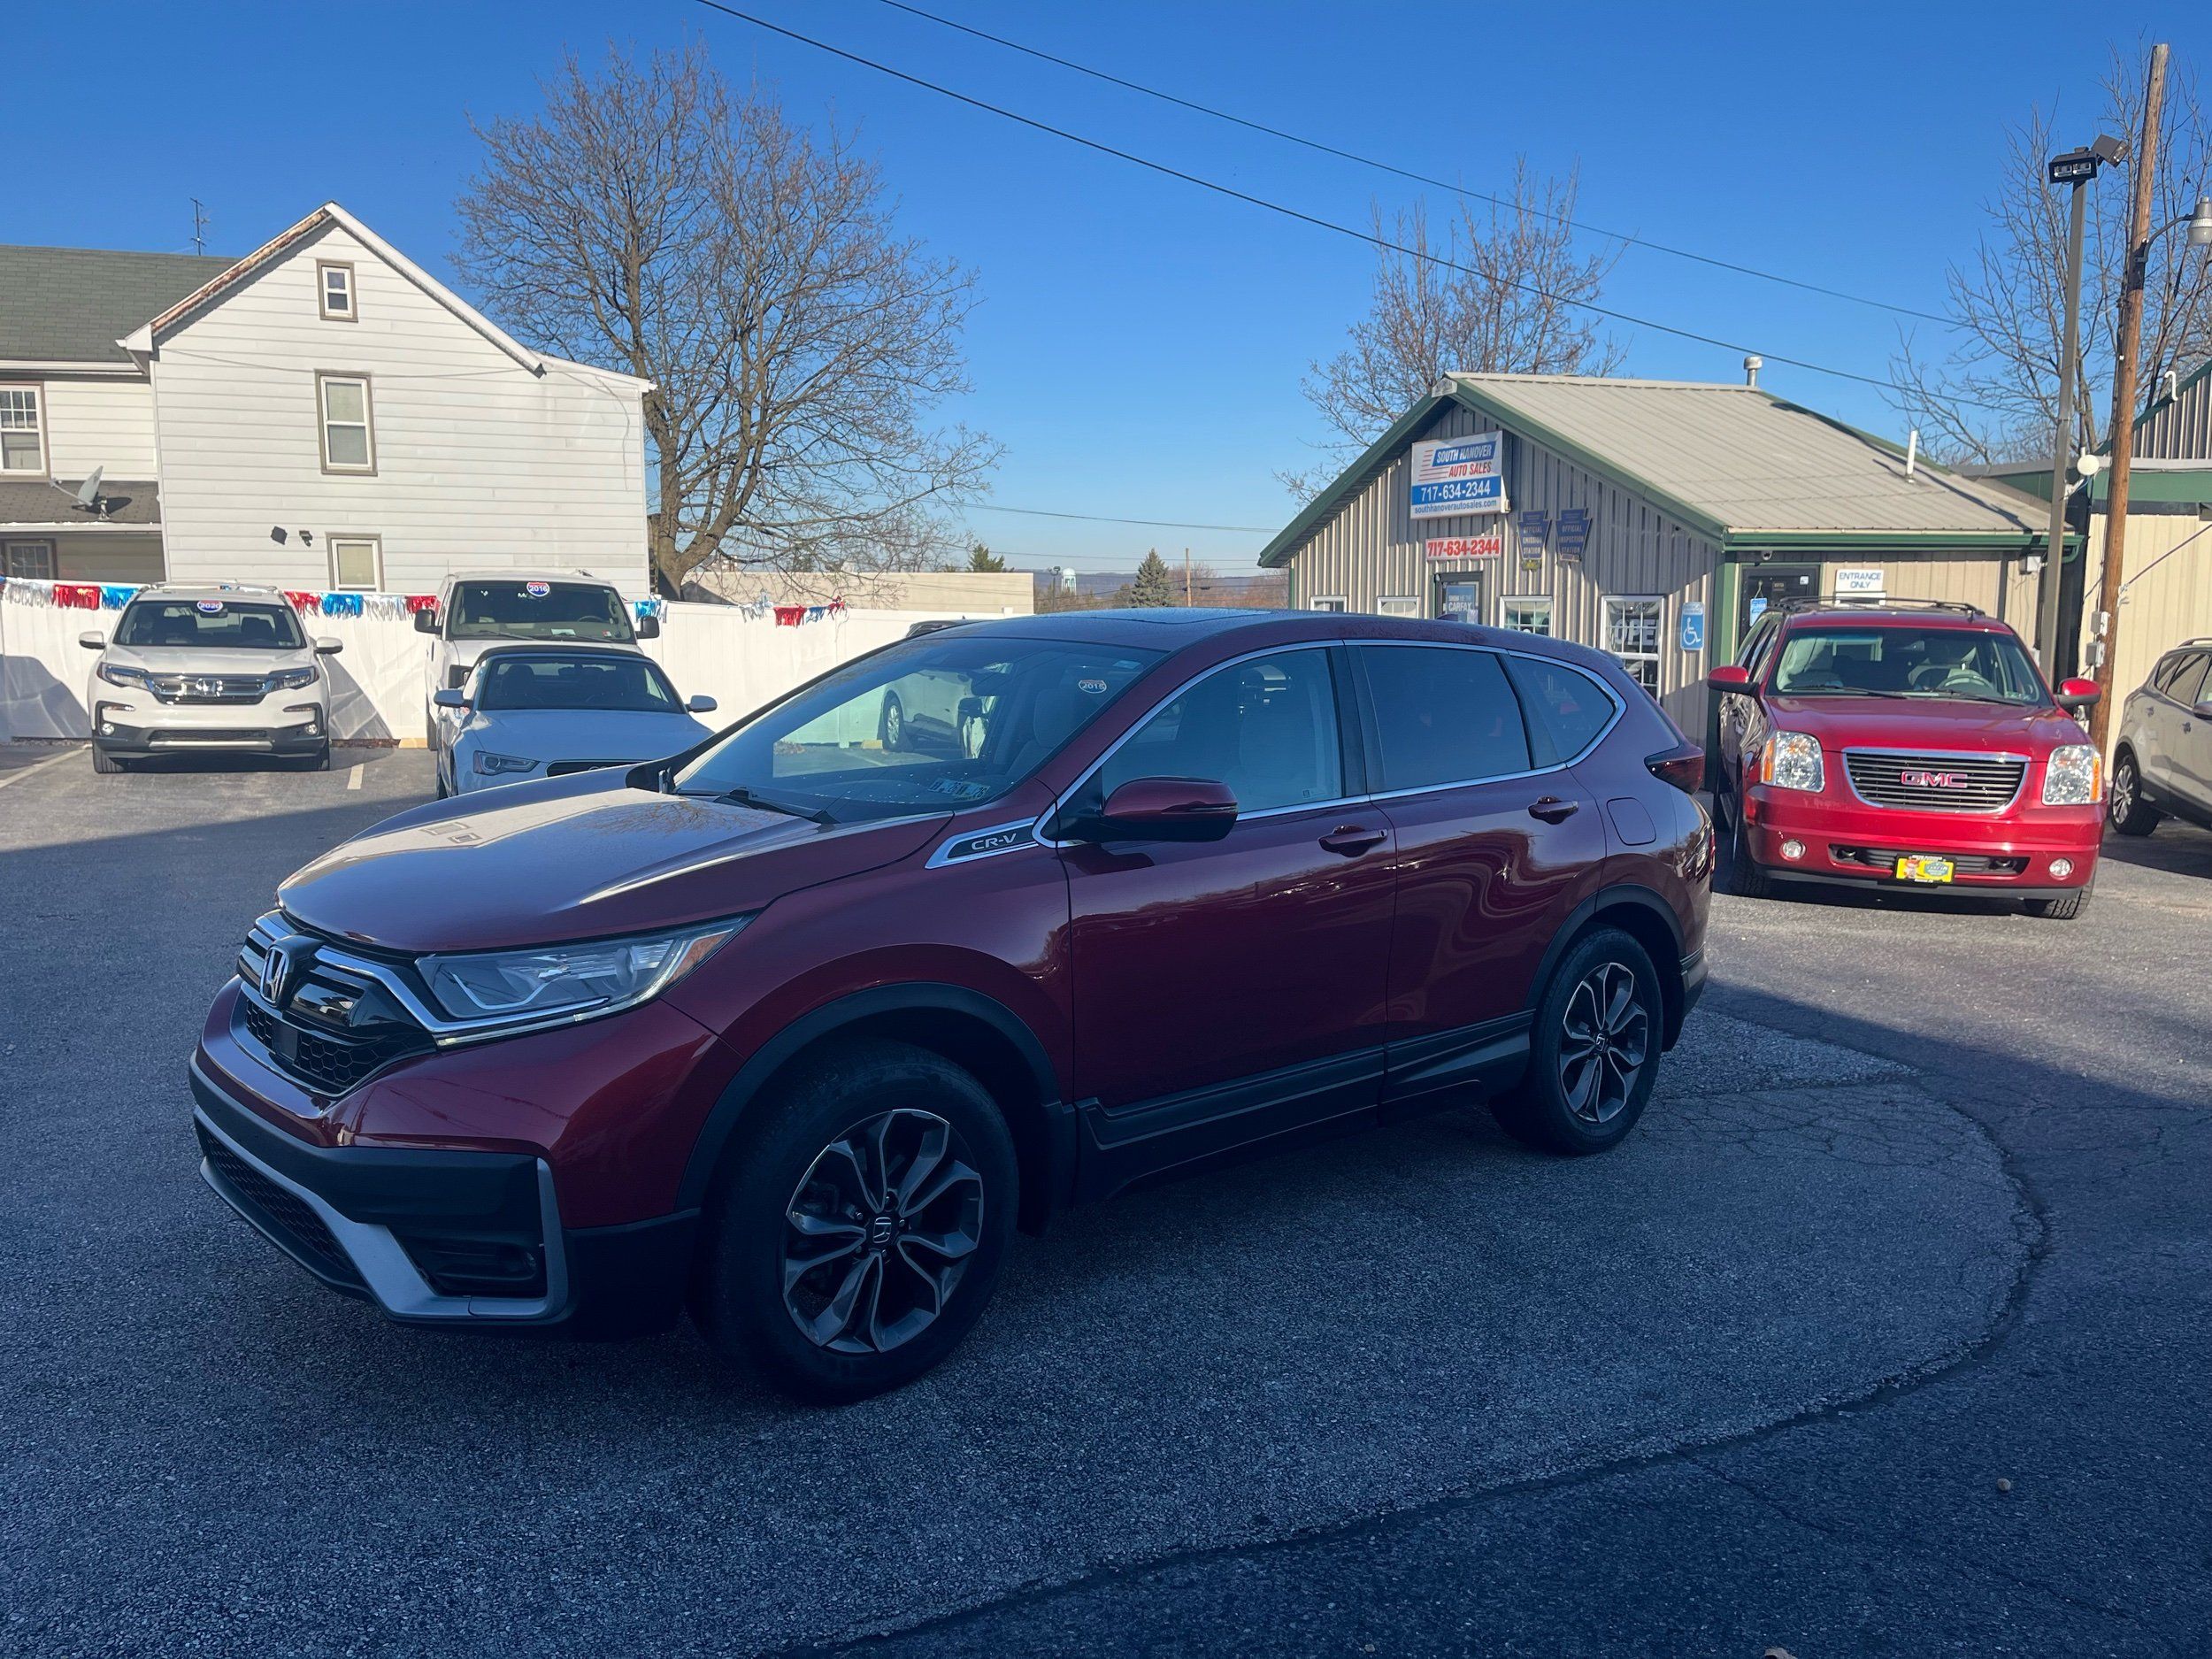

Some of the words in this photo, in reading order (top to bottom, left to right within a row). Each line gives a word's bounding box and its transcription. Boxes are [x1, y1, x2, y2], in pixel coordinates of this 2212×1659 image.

[1437, 449, 1459, 464] SOUTH
[1460, 444, 1493, 460] HANOVER
[1448, 465, 1468, 478] AUTO
[1469, 461, 1492, 475] SALES
[1420, 480, 1491, 502] 717-634-2344
[1414, 499, 1497, 514] southhanoverautosales.com
[1427, 538, 1500, 557] 717-634-2344
[1839, 572, 1882, 580] ENTRANCE
[1850, 580, 1871, 589] ONLY
[199, 602, 221, 611] 2020
[1614, 618, 1660, 646] OPE
[1901, 771, 1969, 789] GMC
[972, 833, 1017, 851] CR-V
